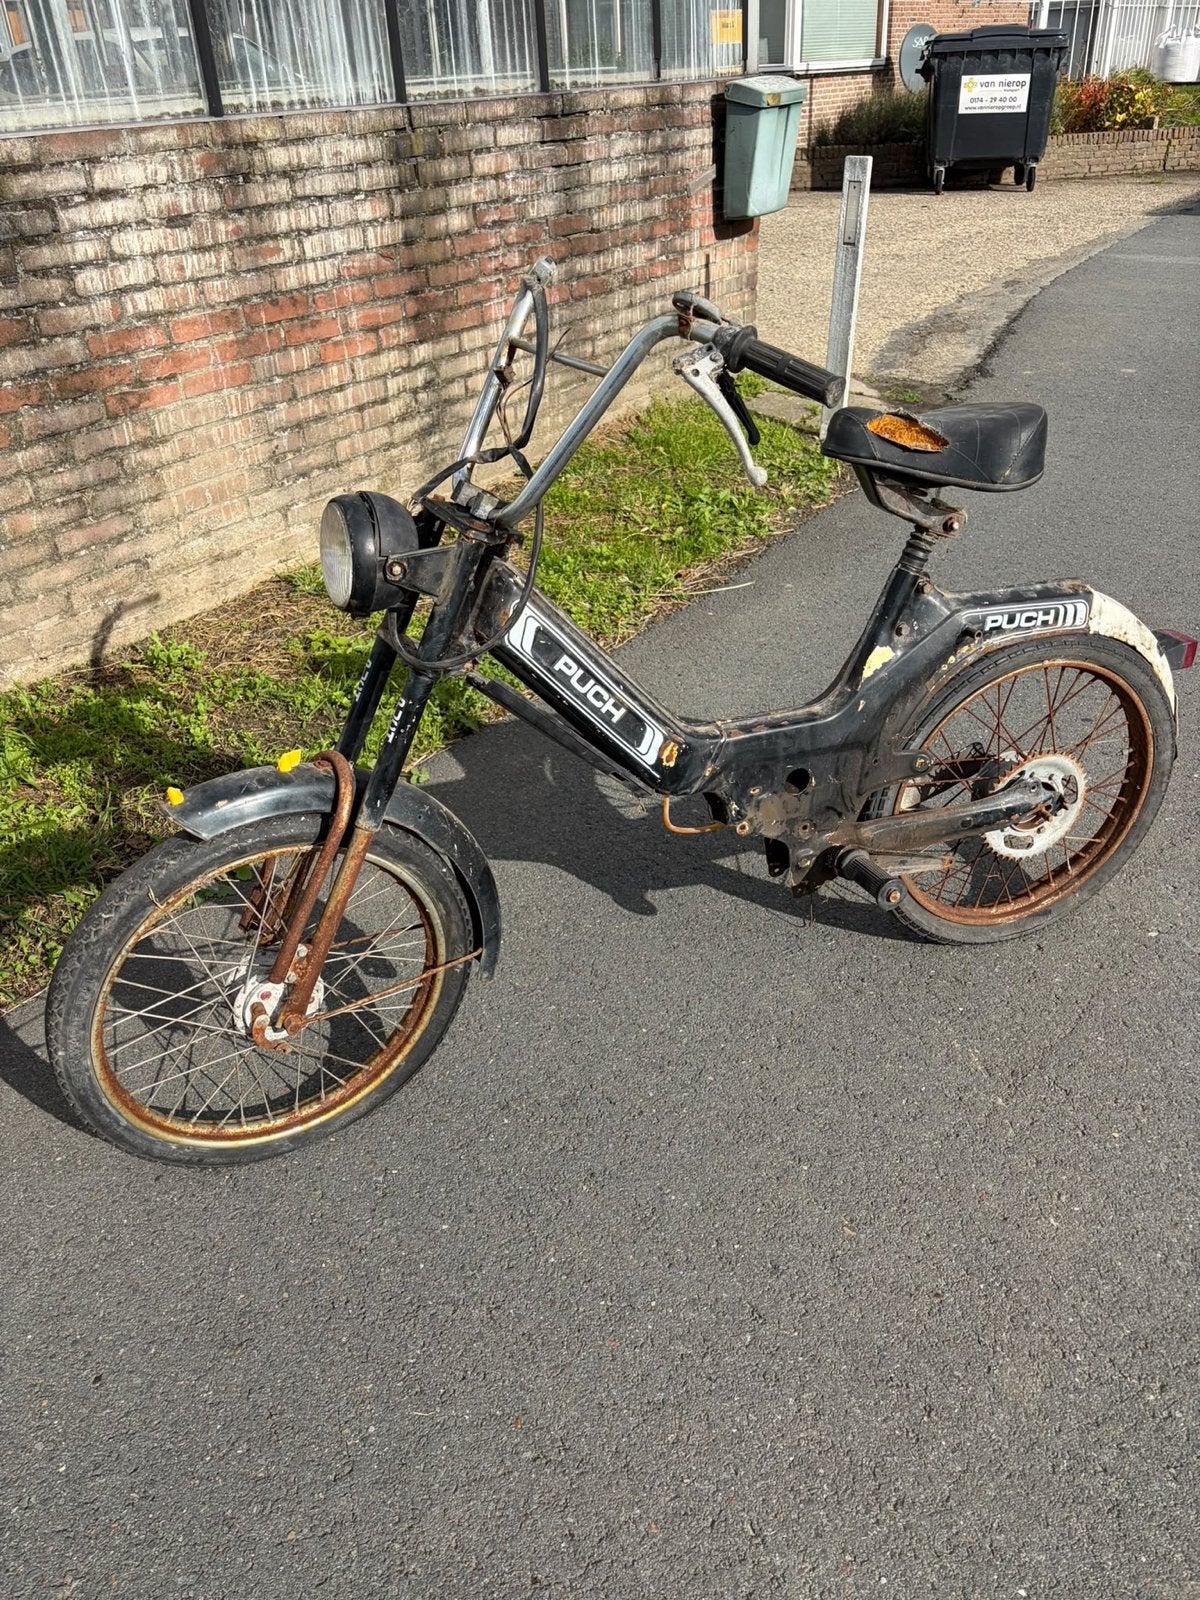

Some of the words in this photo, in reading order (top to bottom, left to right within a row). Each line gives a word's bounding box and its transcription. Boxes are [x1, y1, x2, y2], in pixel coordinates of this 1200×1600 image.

[998, 78, 1027, 89] nierop
[984, 609, 1056, 631] PUCH
[553, 655, 626, 723] PUCH
